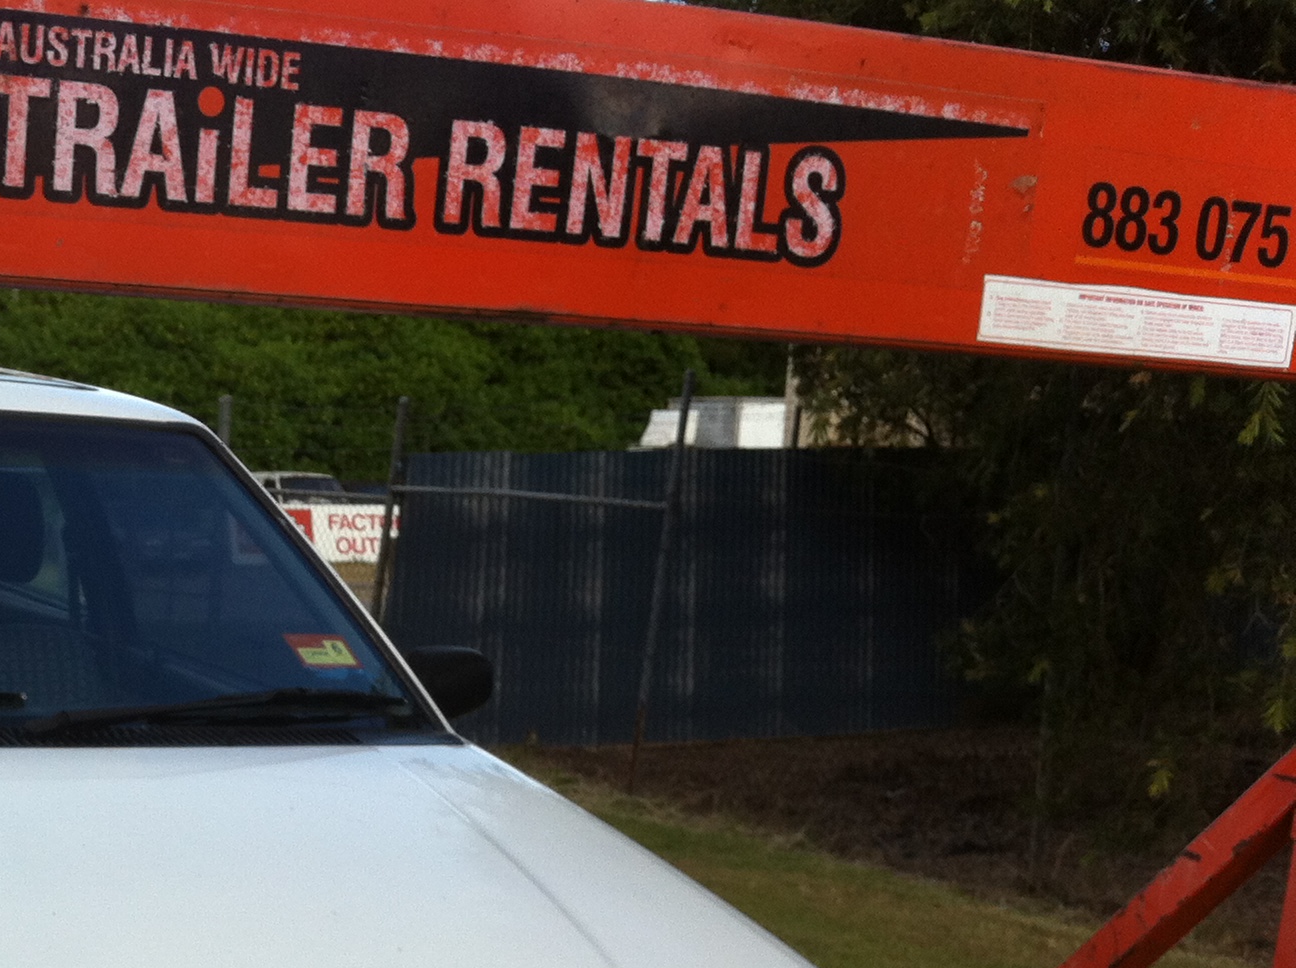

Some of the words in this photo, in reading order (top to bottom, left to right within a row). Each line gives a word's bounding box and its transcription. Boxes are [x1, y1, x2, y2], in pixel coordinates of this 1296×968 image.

[209, 42, 301, 91] WIDE
[442, 118, 839, 258] RENTALS
[1082, 181, 1182, 255] 883
[1196, 195, 1292, 268] 075
